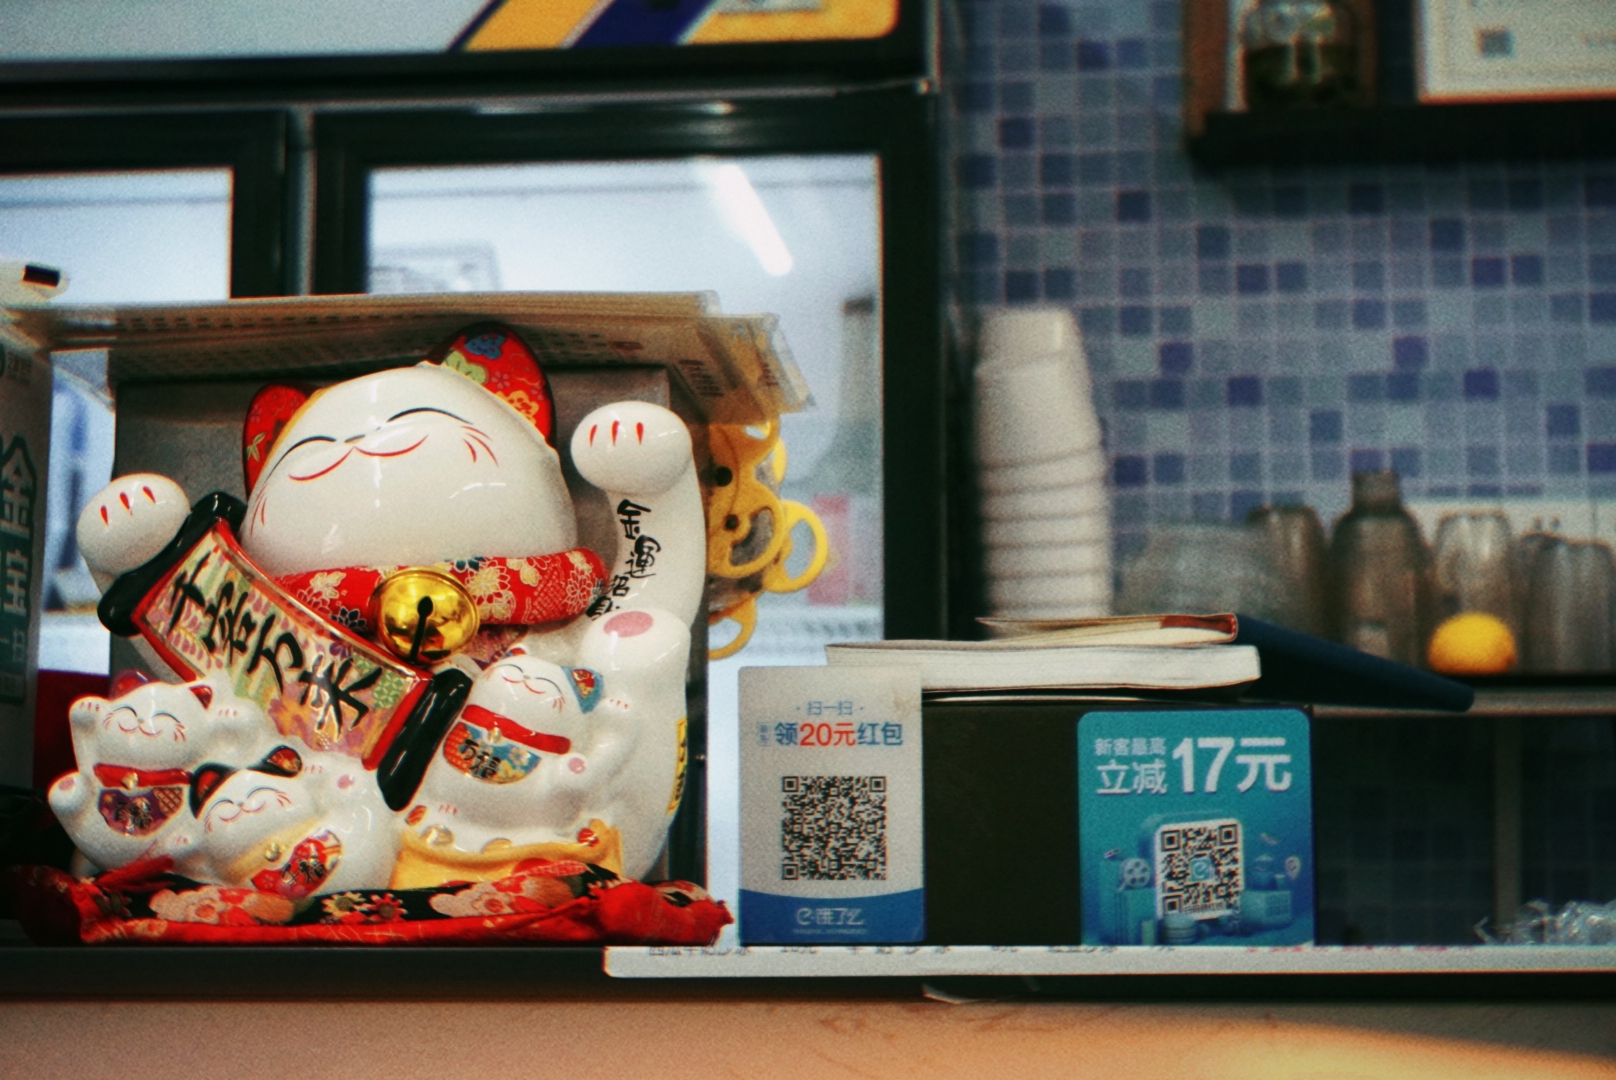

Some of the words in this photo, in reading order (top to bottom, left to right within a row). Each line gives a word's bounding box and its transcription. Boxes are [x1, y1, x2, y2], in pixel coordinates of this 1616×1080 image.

[807, 700, 853, 716] 扫一扫
[774, 721, 903, 747] 领20元红包
[1096, 758, 1168, 795] 立减
[1172, 736, 1292, 794] 17元
